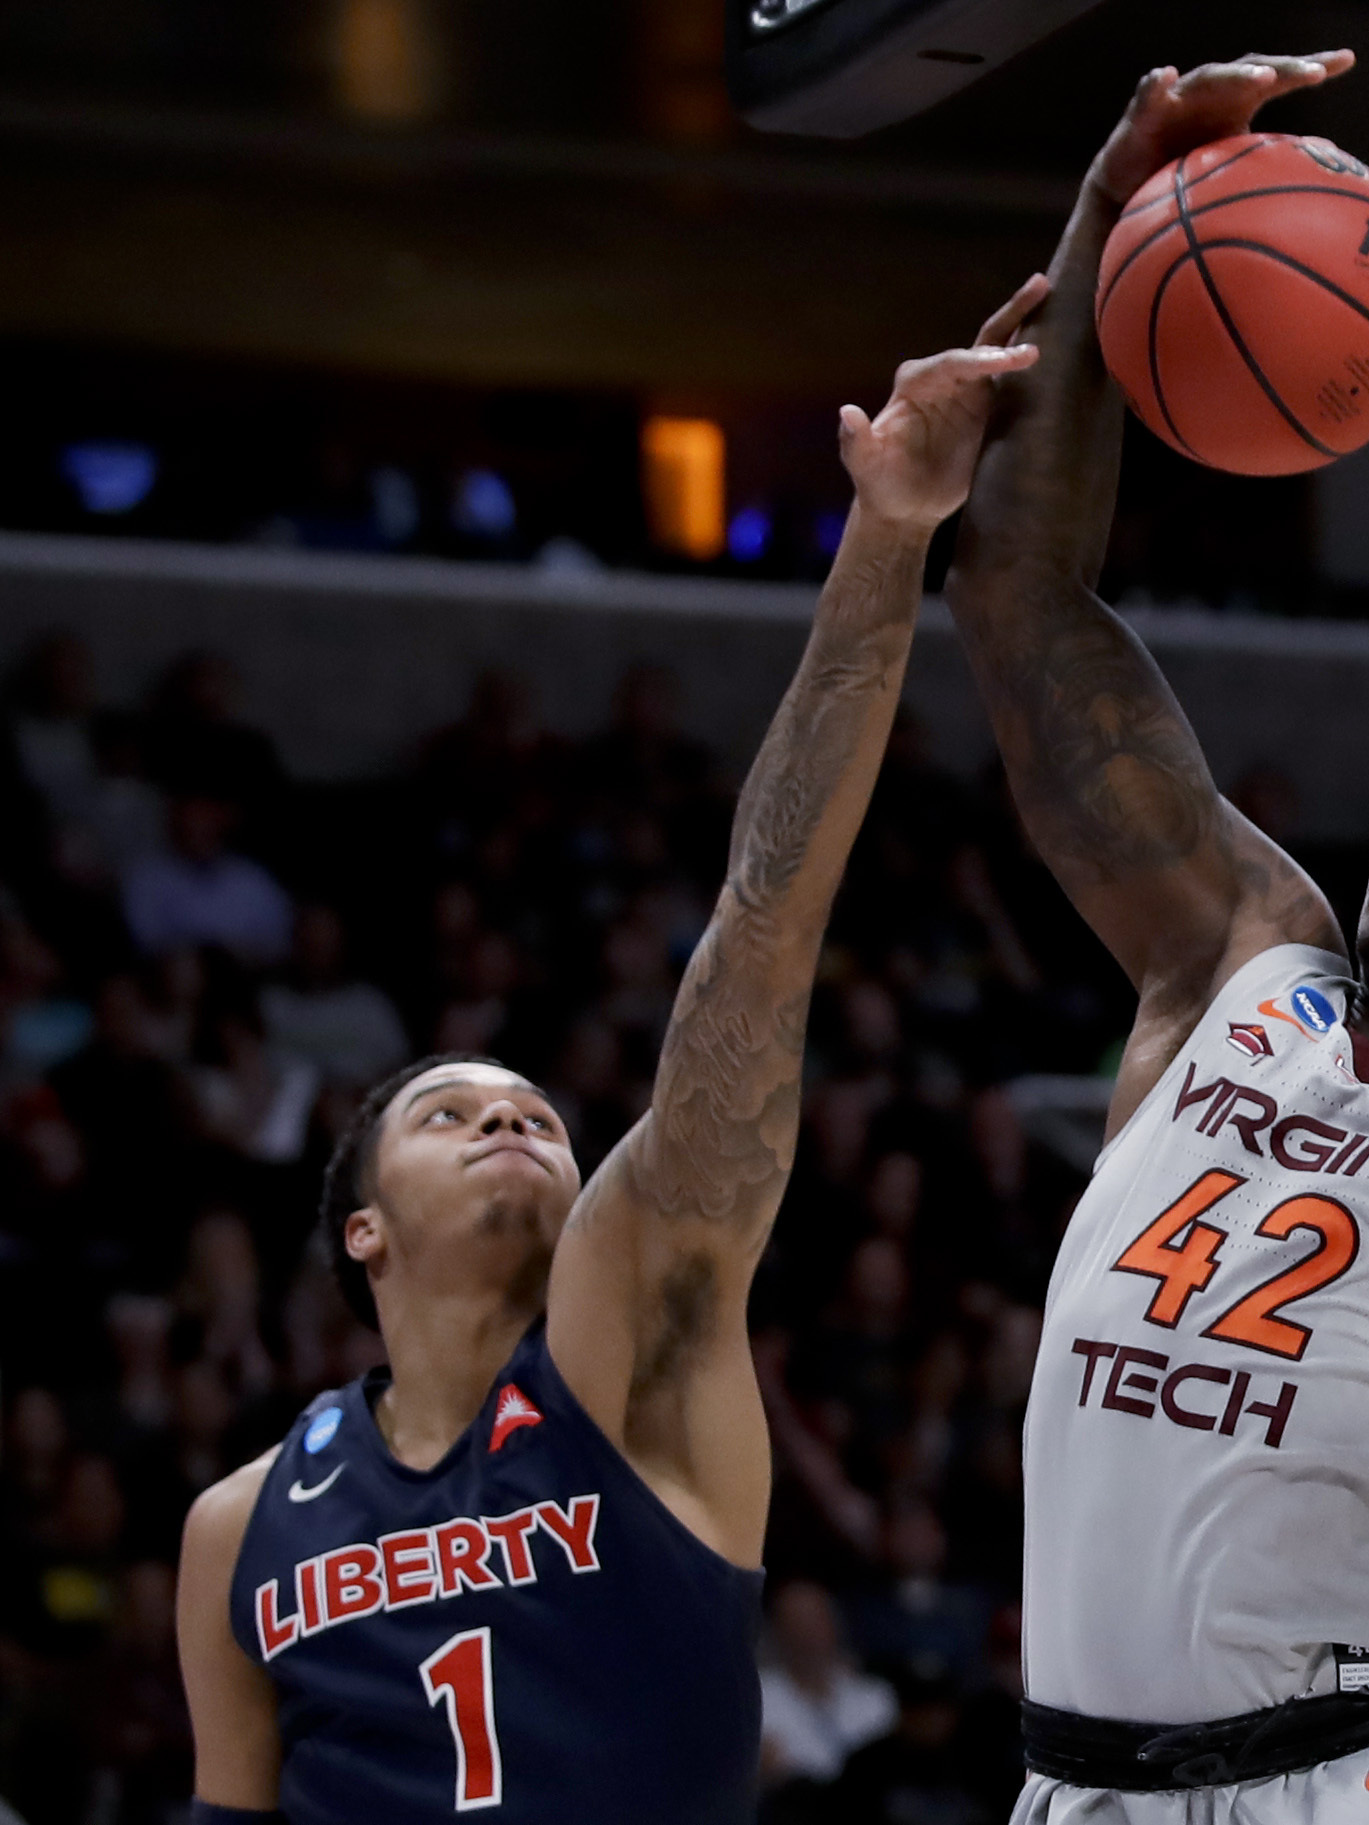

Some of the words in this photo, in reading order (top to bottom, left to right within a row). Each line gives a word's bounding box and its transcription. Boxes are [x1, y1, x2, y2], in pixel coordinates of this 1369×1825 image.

[1295, 992, 1328, 1030] NCAA
[1110, 1167, 1361, 1361] 42
[1072, 1337, 1298, 1449] TECH
[256, 1494, 600, 1661] LIBERTY
[419, 1626, 502, 1812] 1
